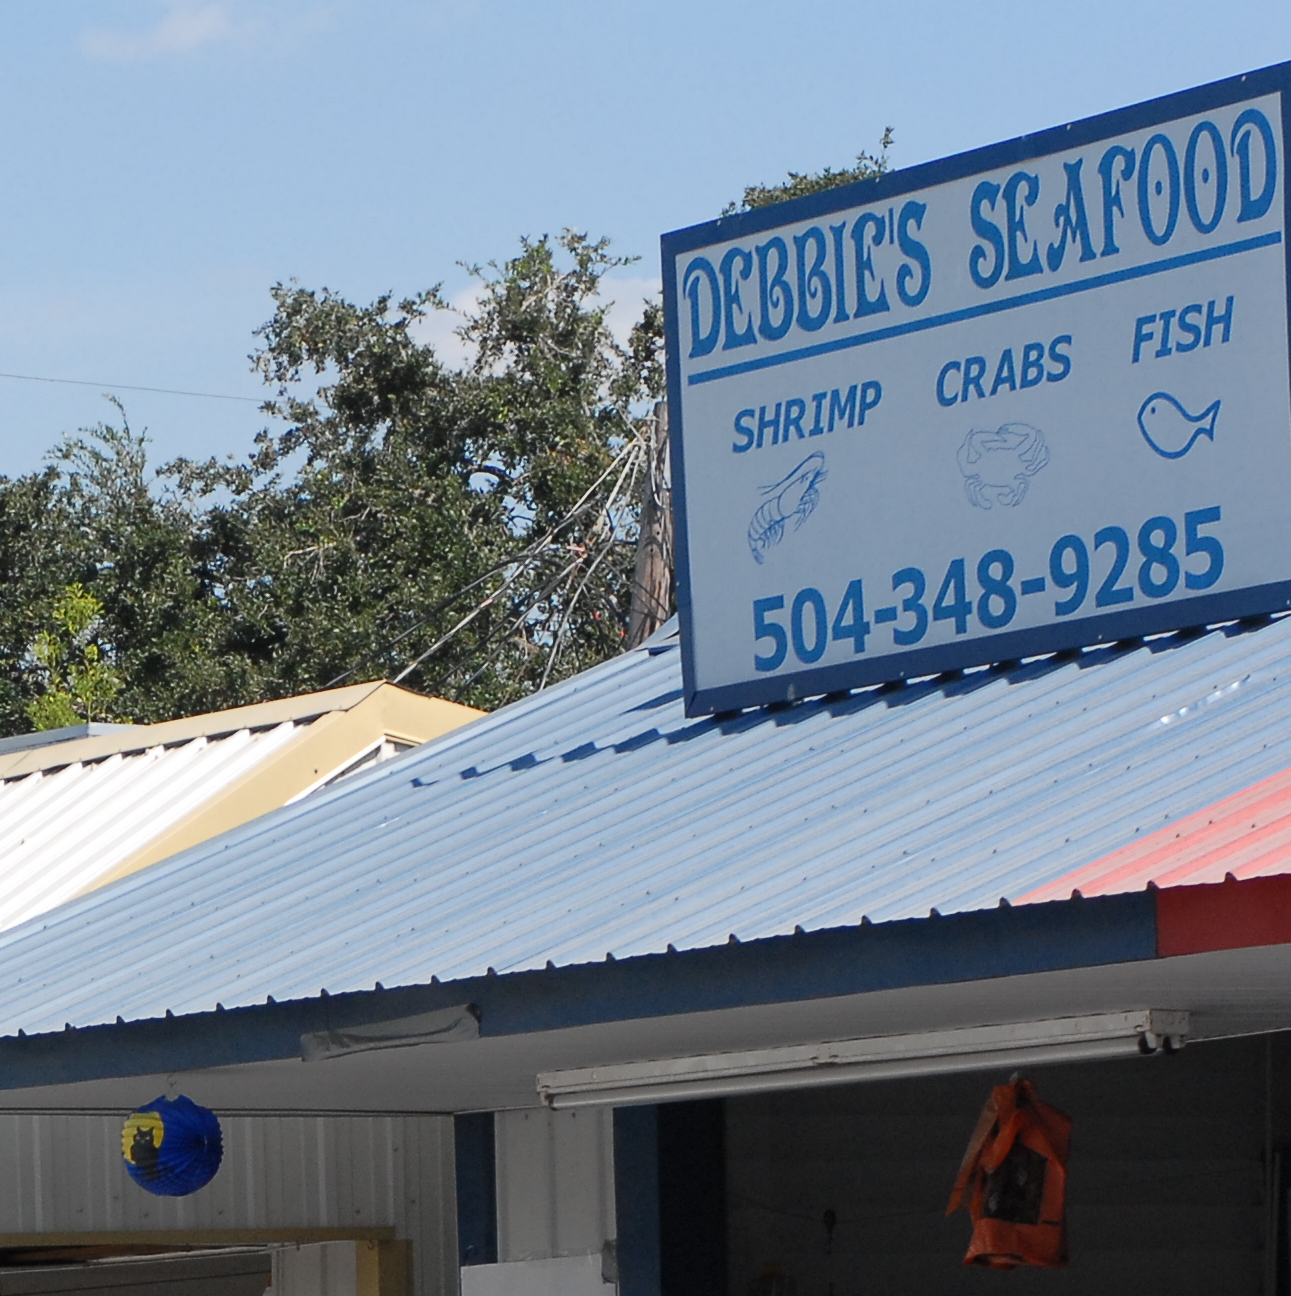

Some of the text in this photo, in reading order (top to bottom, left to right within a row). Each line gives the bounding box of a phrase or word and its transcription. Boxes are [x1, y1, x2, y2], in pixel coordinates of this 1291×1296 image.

[683, 108, 1277, 358] DEBBIE'S SEAFOOD
[732, 296, 1234, 453] SHRIMP CRABS FISH
[753, 506, 1225, 672] 504-348-9285
